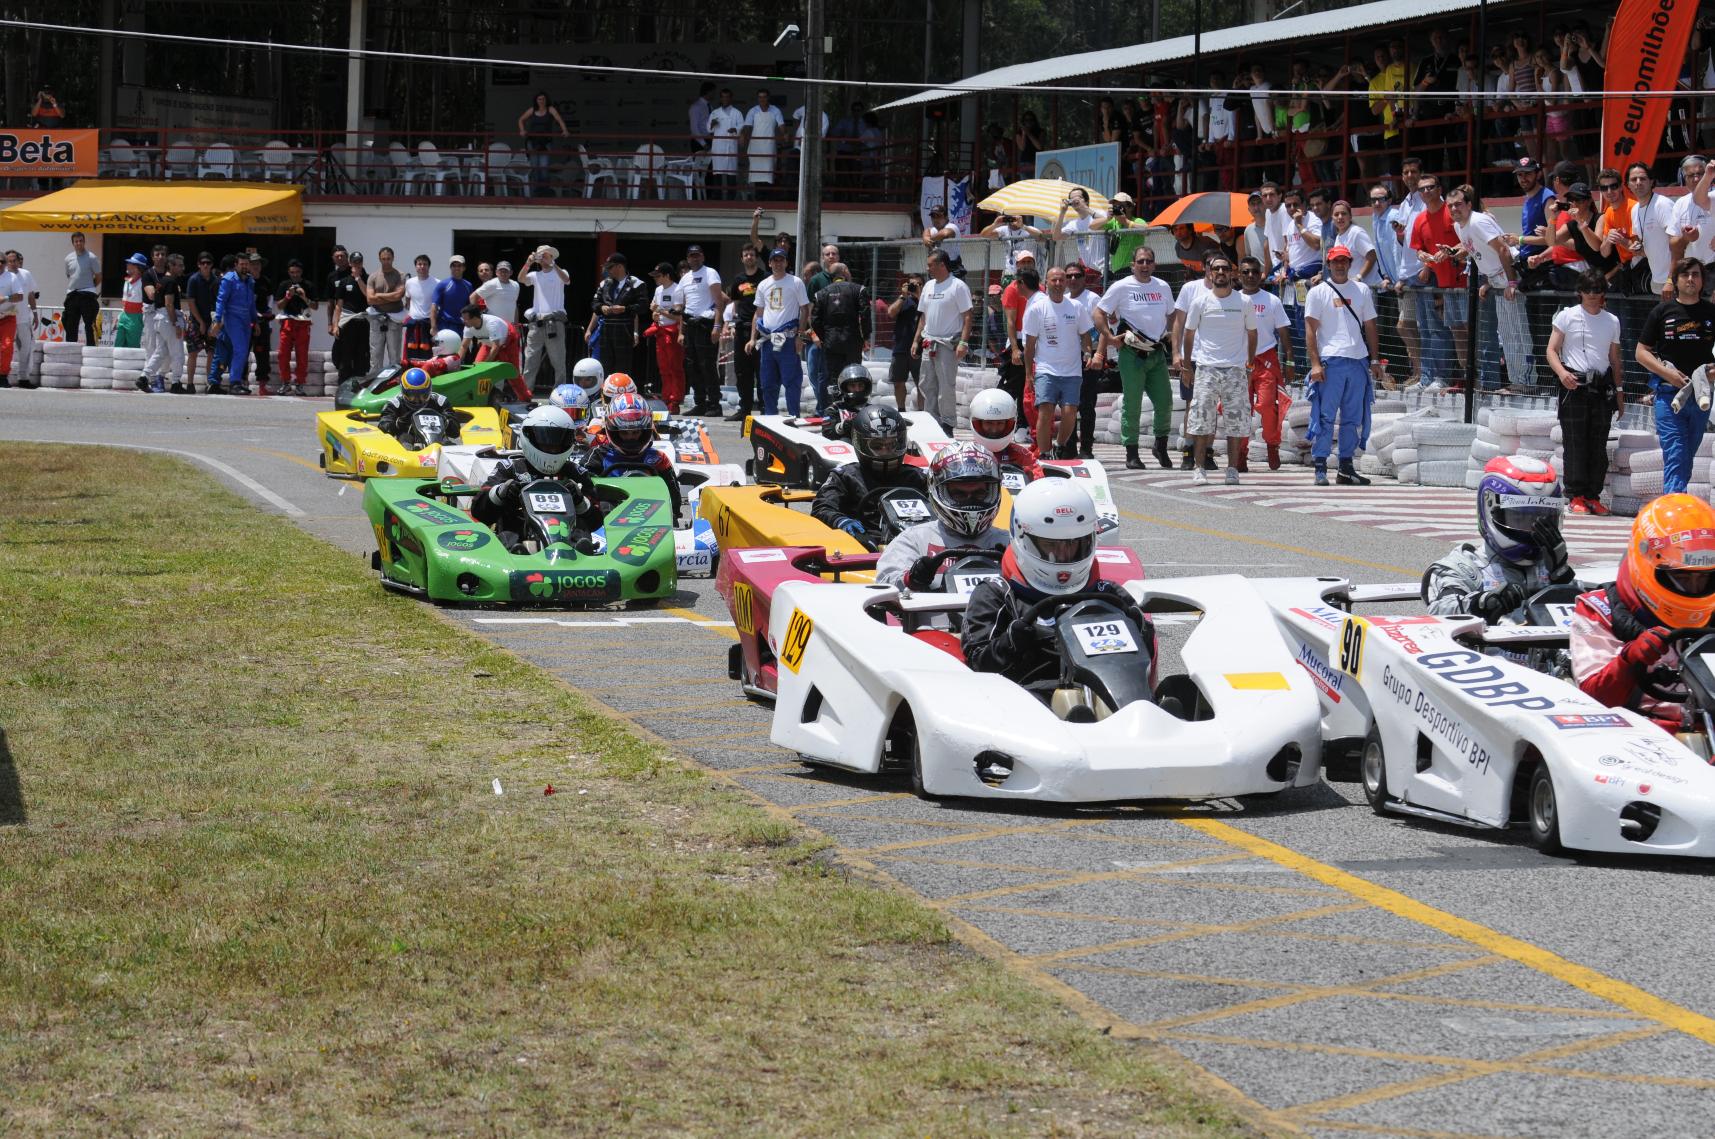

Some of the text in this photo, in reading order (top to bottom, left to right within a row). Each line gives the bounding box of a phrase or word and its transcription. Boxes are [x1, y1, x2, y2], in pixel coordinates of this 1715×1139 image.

[0, 134, 75, 164] Beta
[1133, 292, 1163, 302] UNITRIP
[534, 494, 561, 503] 89
[896, 500, 919, 509] 67
[718, 503, 732, 537] 67
[631, 527, 659, 546] JOGOS
[557, 575, 607, 593] JOGOS
[734, 587, 754, 633] 100
[781, 610, 813, 667] 129
[1082, 623, 1121, 638] 129
[1341, 618, 1362, 676] 90
[1298, 644, 1343, 691] Mucoral
[1416, 651, 1556, 711] GDBP
[1383, 664, 1491, 776] Grupo Desportivo BPI
[1583, 713, 1620, 723] BPI
